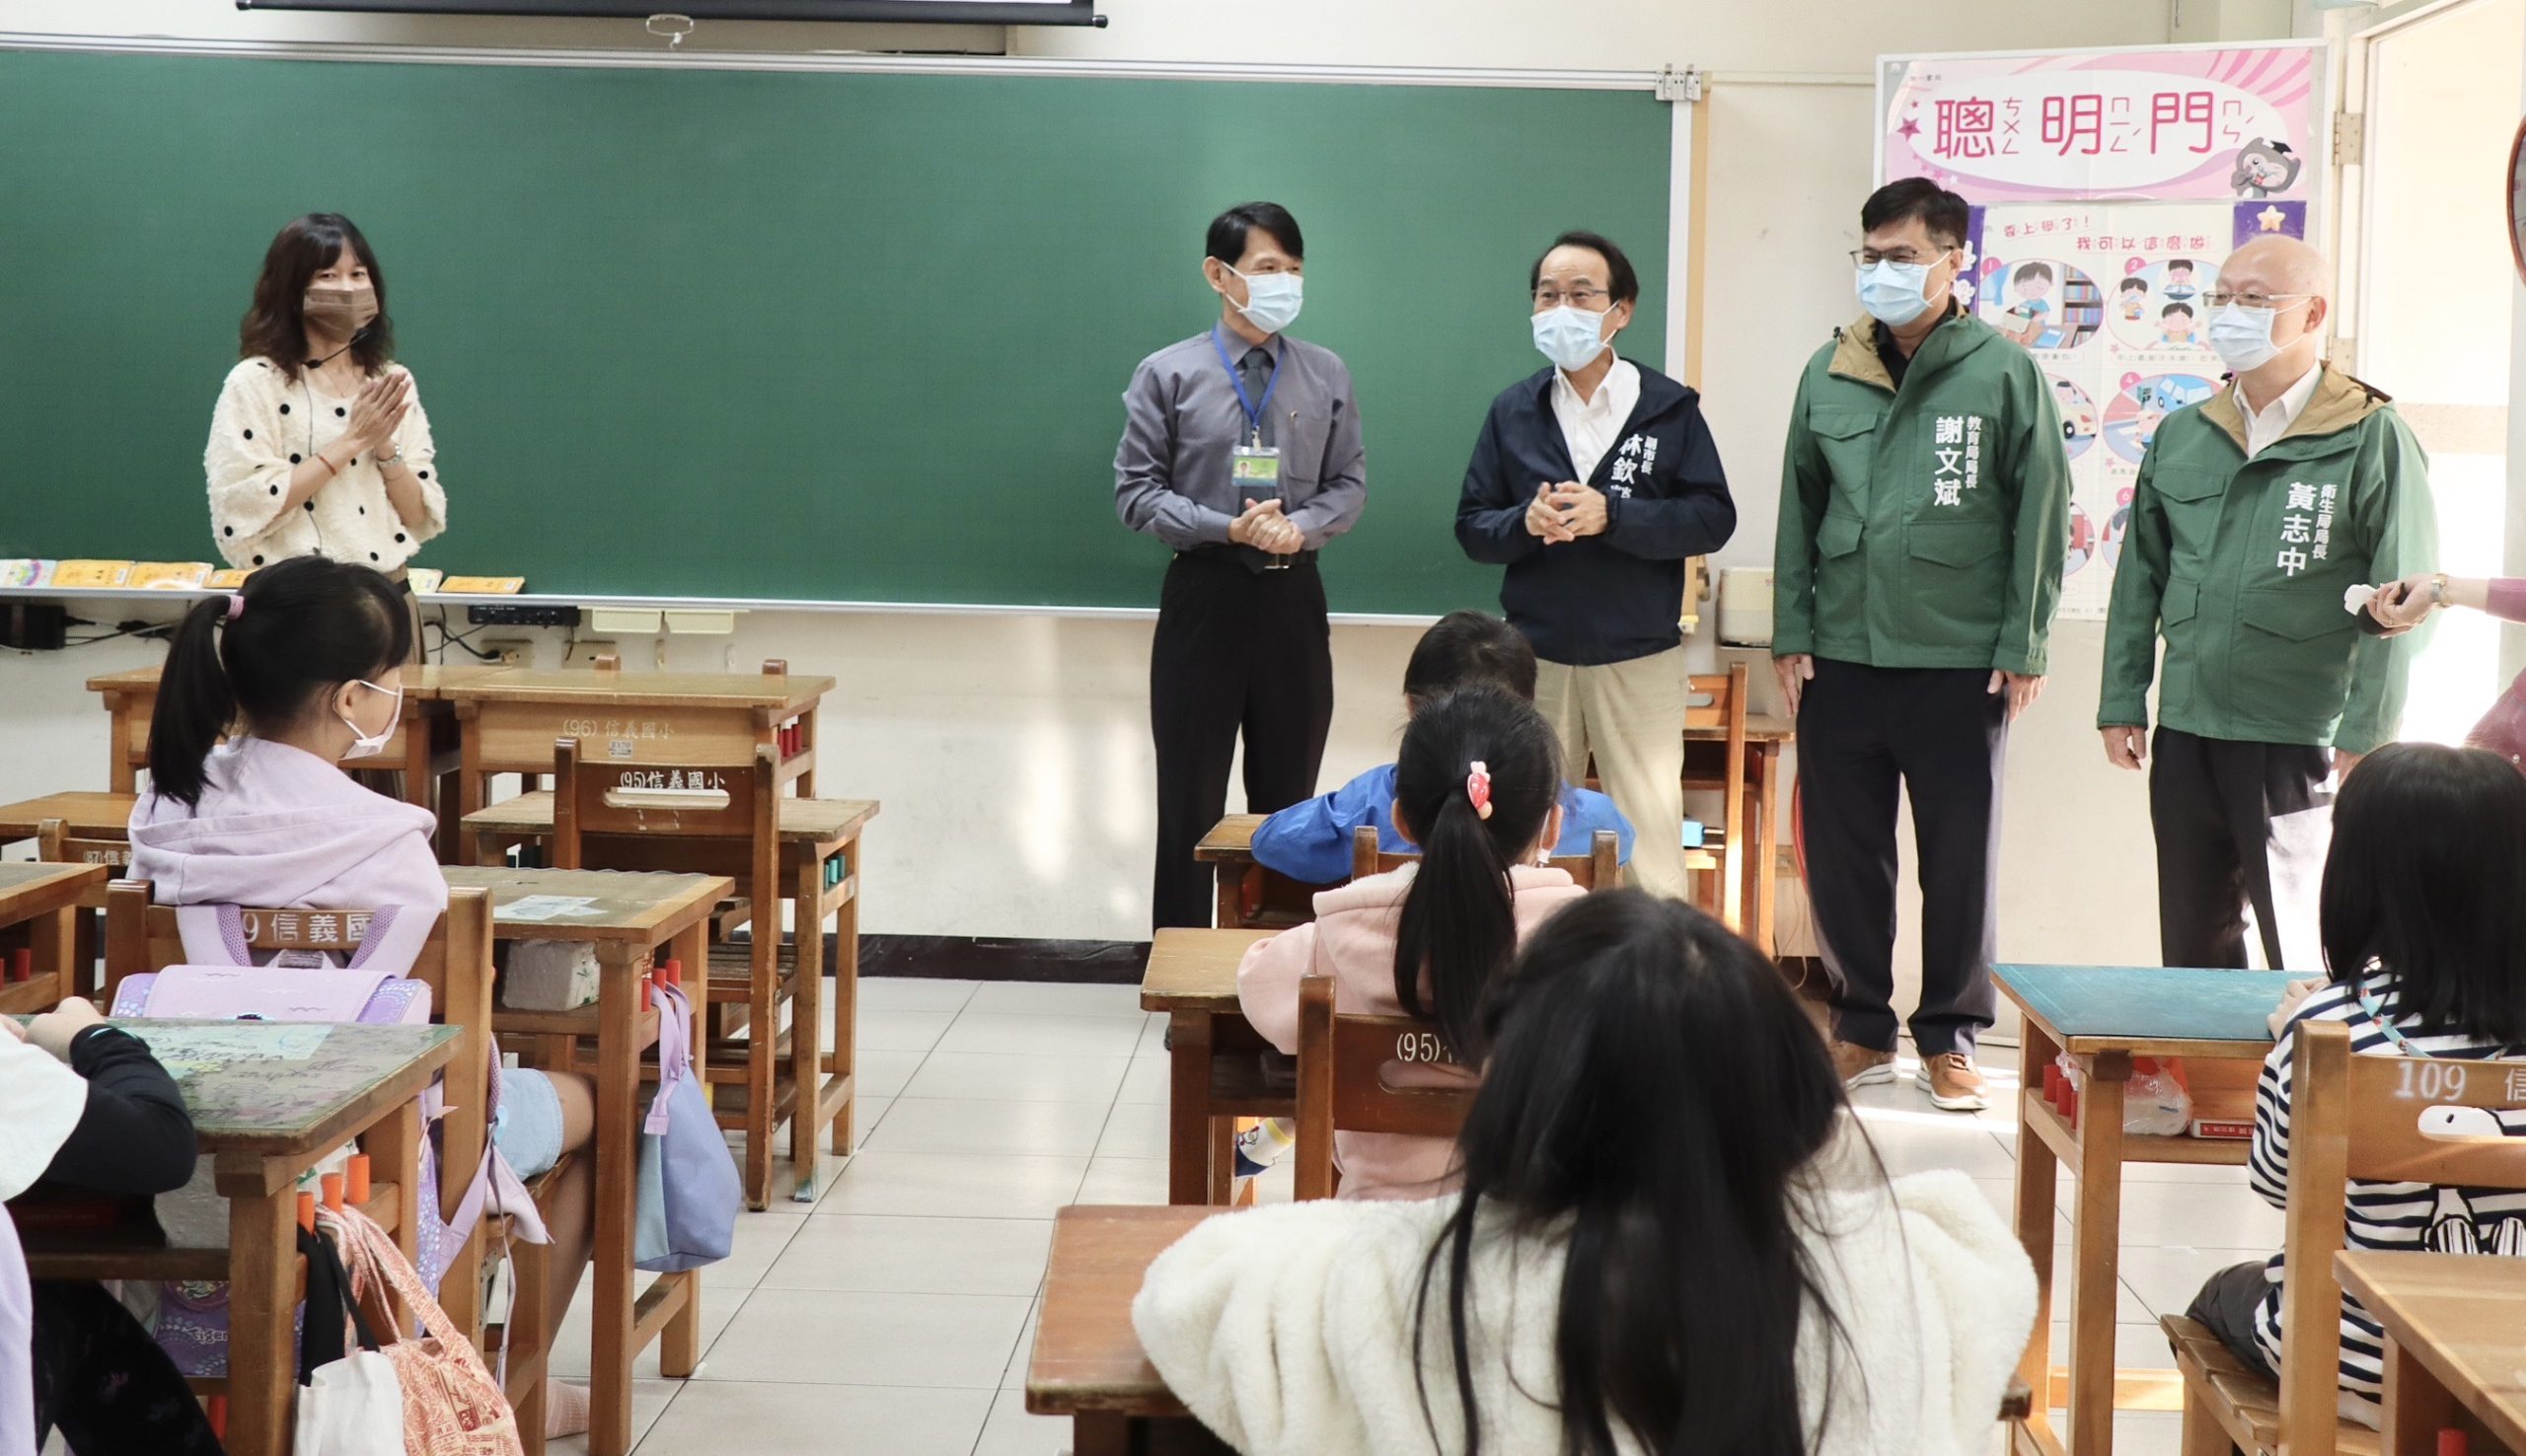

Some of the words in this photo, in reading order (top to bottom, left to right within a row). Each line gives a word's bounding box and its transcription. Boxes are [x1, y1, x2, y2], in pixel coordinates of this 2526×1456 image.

[1933, 91, 2214, 159] 聰明門
[2130, 259, 2139, 270] 2
[1934, 415, 1964, 506] 謝文斌
[1966, 415, 1982, 489] 教育局局長
[2276, 481, 2318, 577] 黃志中
[2312, 483, 2338, 560] 衛生局局長
[562, 719, 598, 737] (96)
[606, 719, 676, 740] 信義國小
[1396, 1032, 1453, 1063] (95)
[2394, 1059, 2467, 1102] 109
